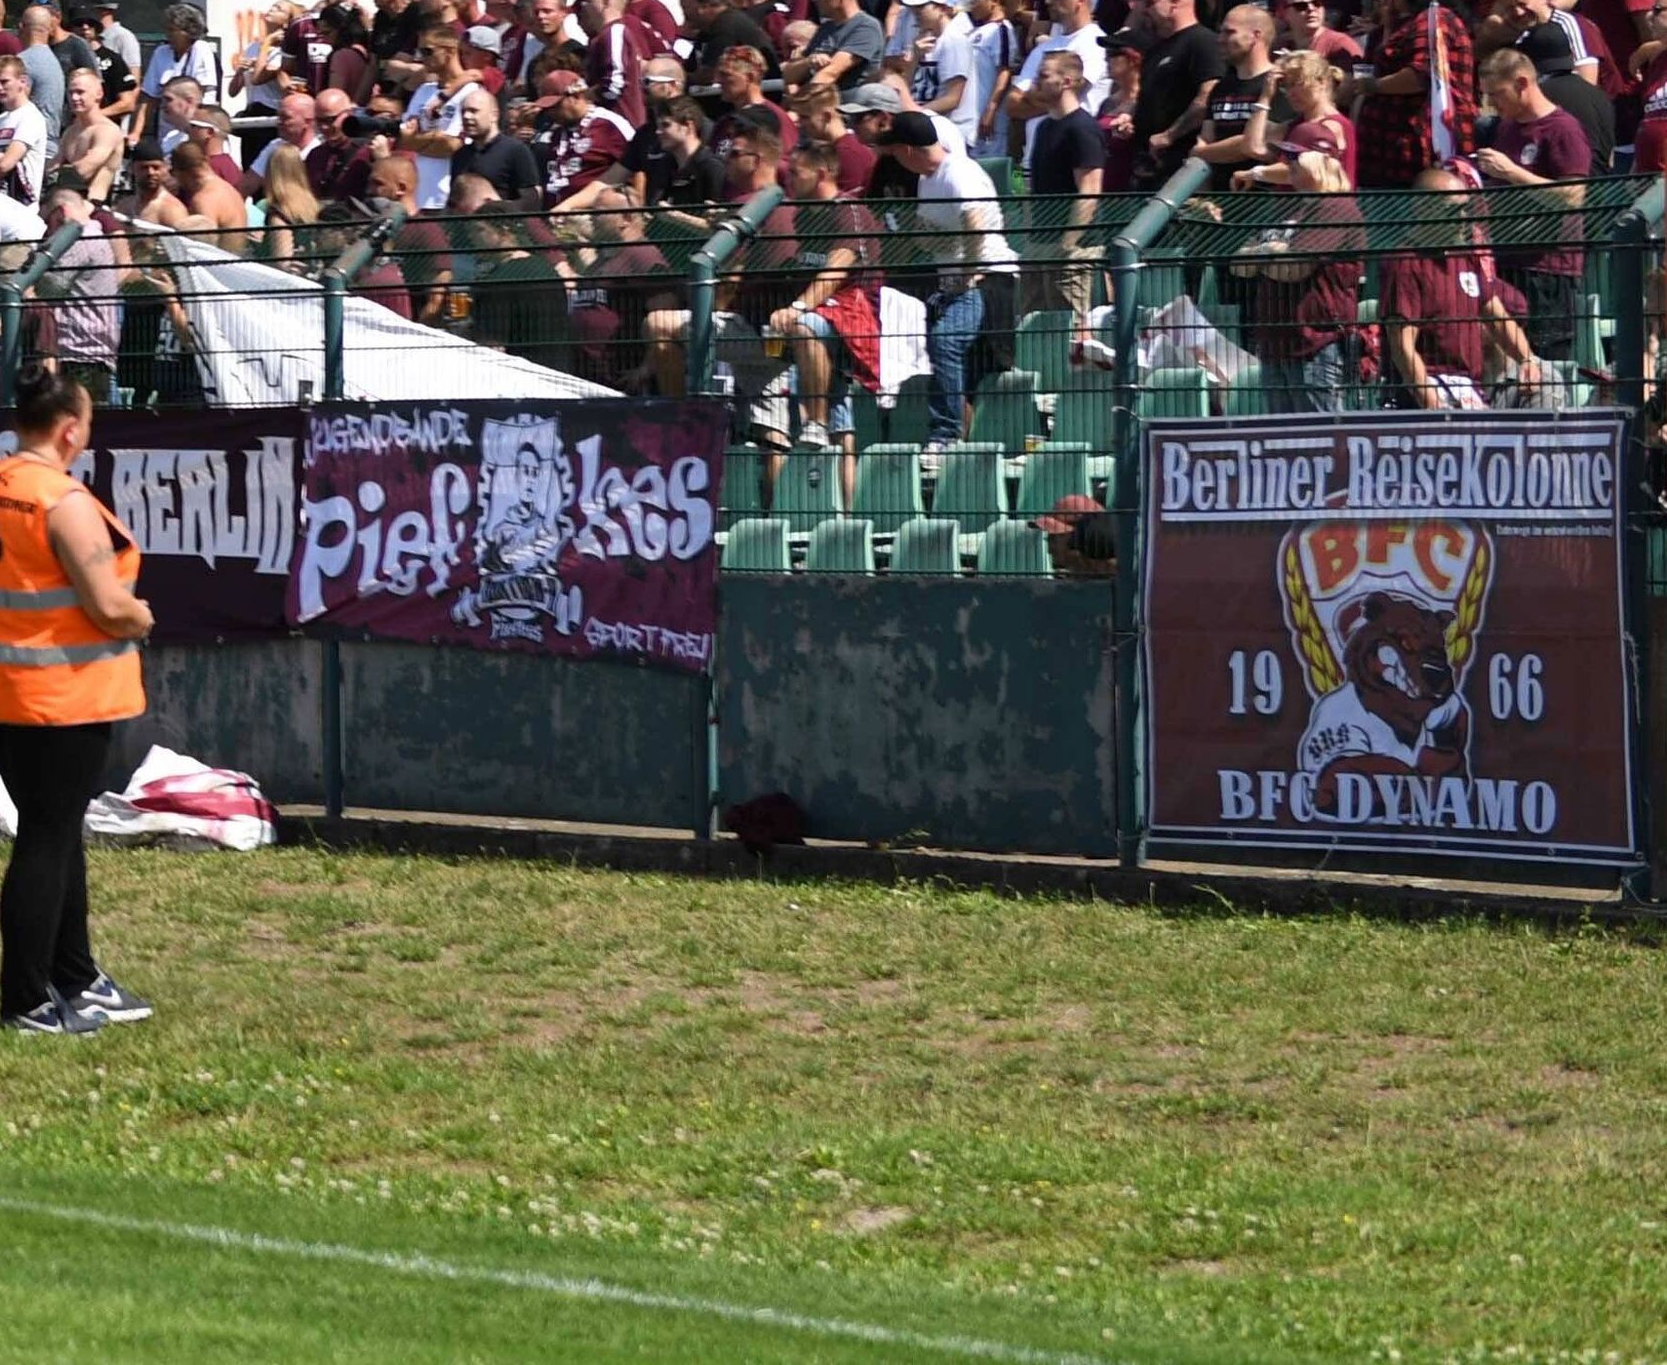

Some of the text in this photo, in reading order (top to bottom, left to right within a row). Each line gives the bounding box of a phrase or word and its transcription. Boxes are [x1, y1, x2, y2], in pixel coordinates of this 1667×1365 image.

[107, 436, 295, 574] BERLIN
[1162, 437, 1333, 511] Berliner
[1307, 520, 1466, 593] BFC
[584, 617, 657, 652] SPORT
[1228, 650, 1544, 721] 19 66
[1217, 769, 1557, 835] BFC DYNAMO
